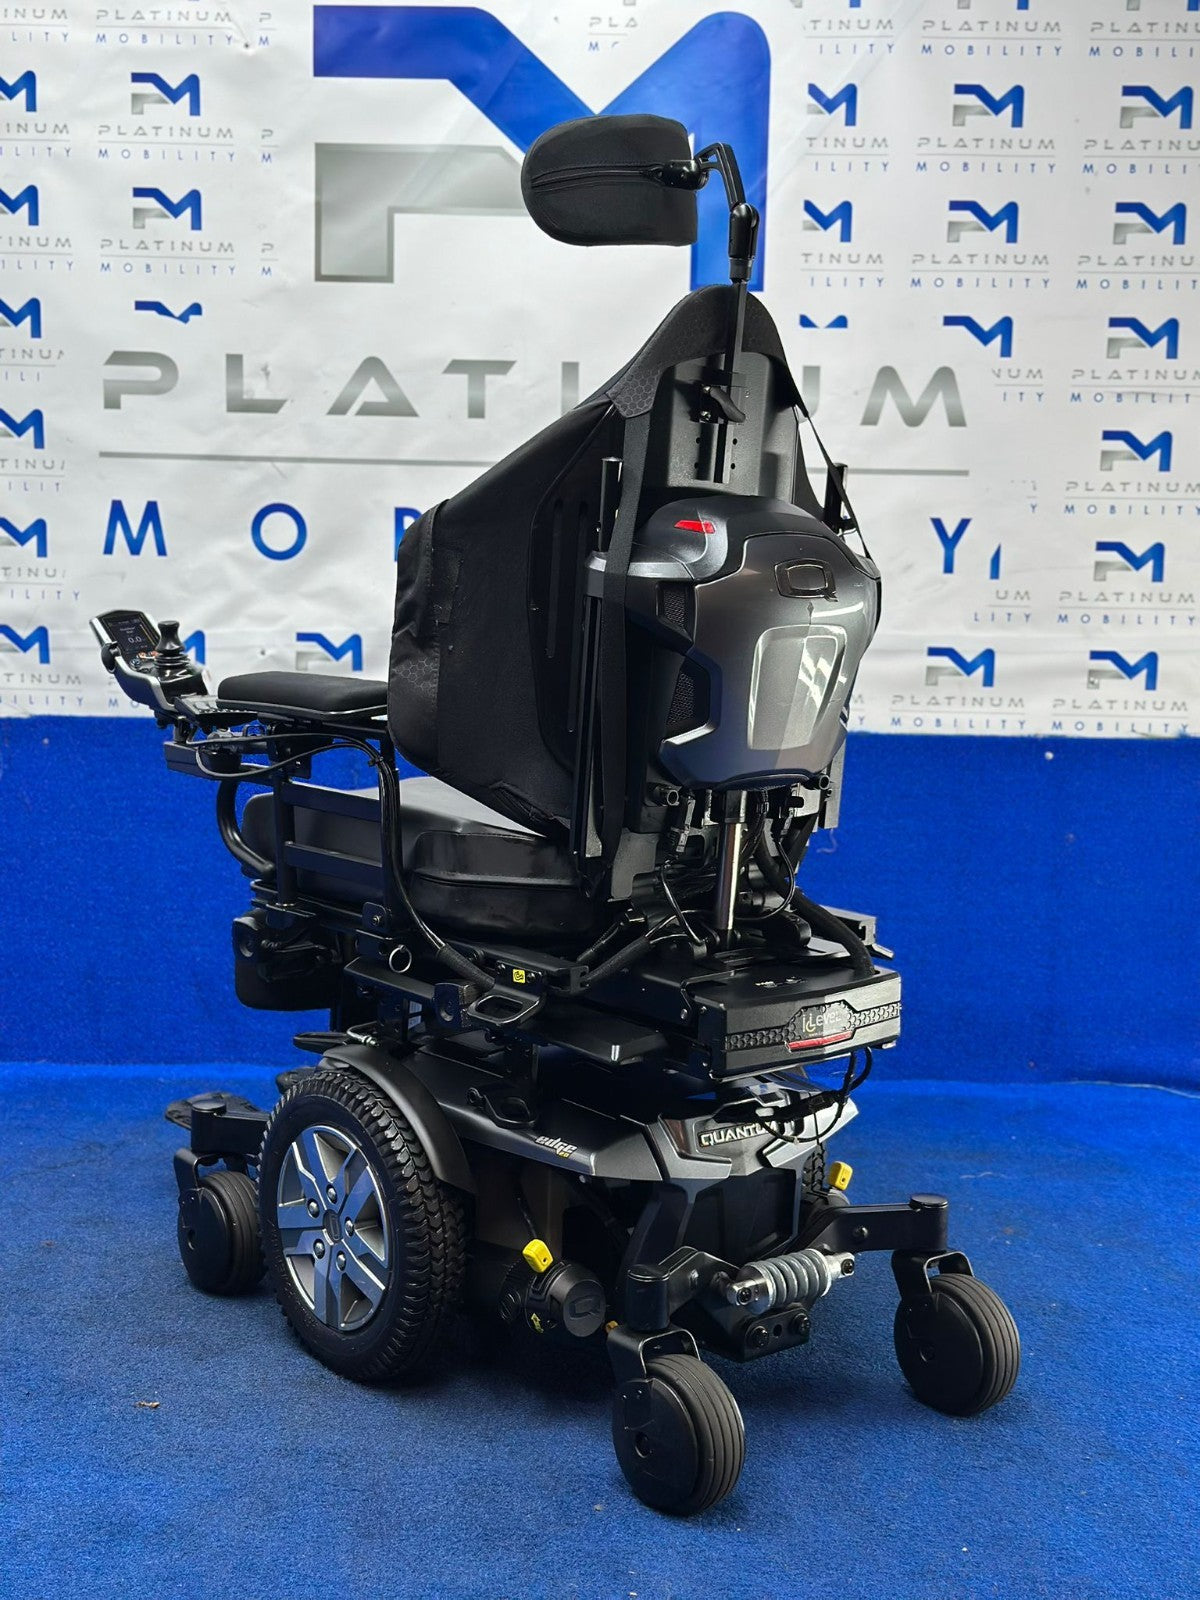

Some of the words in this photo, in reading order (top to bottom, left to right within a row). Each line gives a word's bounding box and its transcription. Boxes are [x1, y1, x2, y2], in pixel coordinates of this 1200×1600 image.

[4, 8, 67, 19] INUM
[96, 9, 233, 22] PLATINUM
[811, 19, 893, 30] TINUM
[922, 20, 1060, 32] PLATINUM
[1091, 22, 1200, 33] PLATIN
[12, 32, 68, 42] LITY
[96, 33, 232, 44] MOBILITY
[820, 44, 894, 54] ILITY
[922, 45, 1061, 56] MOBILITY
[1089, 46, 1193, 57] MOBILI
[6, 123, 69, 134] INUM
[98, 125, 233, 138] PLATINUM
[807, 137, 888, 148] TINUM
[918, 137, 1054, 149] PLATINUM
[1084, 139, 1200, 150] PLATINU
[0, 147, 71, 157] ILITY
[98, 149, 234, 161] MOBILITY
[815, 162, 888, 172] ILITY
[916, 162, 1055, 173] MOBILITY
[1083, 163, 1186, 174] MOBILI
[9, 237, 71, 247] INUM
[101, 239, 234, 252] PLATINUM
[801, 253, 883, 264] TINUM
[912, 254, 1049, 265] PLATINUM
[1078, 255, 1194, 266] PLATINU
[2, 260, 73, 270] ILITY
[100, 263, 235, 274] MOBILITY
[811, 277, 884, 287] ILITY
[911, 278, 1049, 288] MOBILITY
[1077, 279, 1196, 289] MOBILIT
[102, 350, 968, 428] PLATIM
[1071, 392, 1190, 403] MOBILIT
[11, 589, 79, 600] ILITY
[1059, 591, 1194, 603] PLATINUM
[974, 612, 1030, 622] LITY
[1058, 614, 1195, 625] MOBILITY
[4, 673, 81, 684] TINUM
[14, 696, 83, 706] ILITY
[535, 1135, 578, 1155] edge
